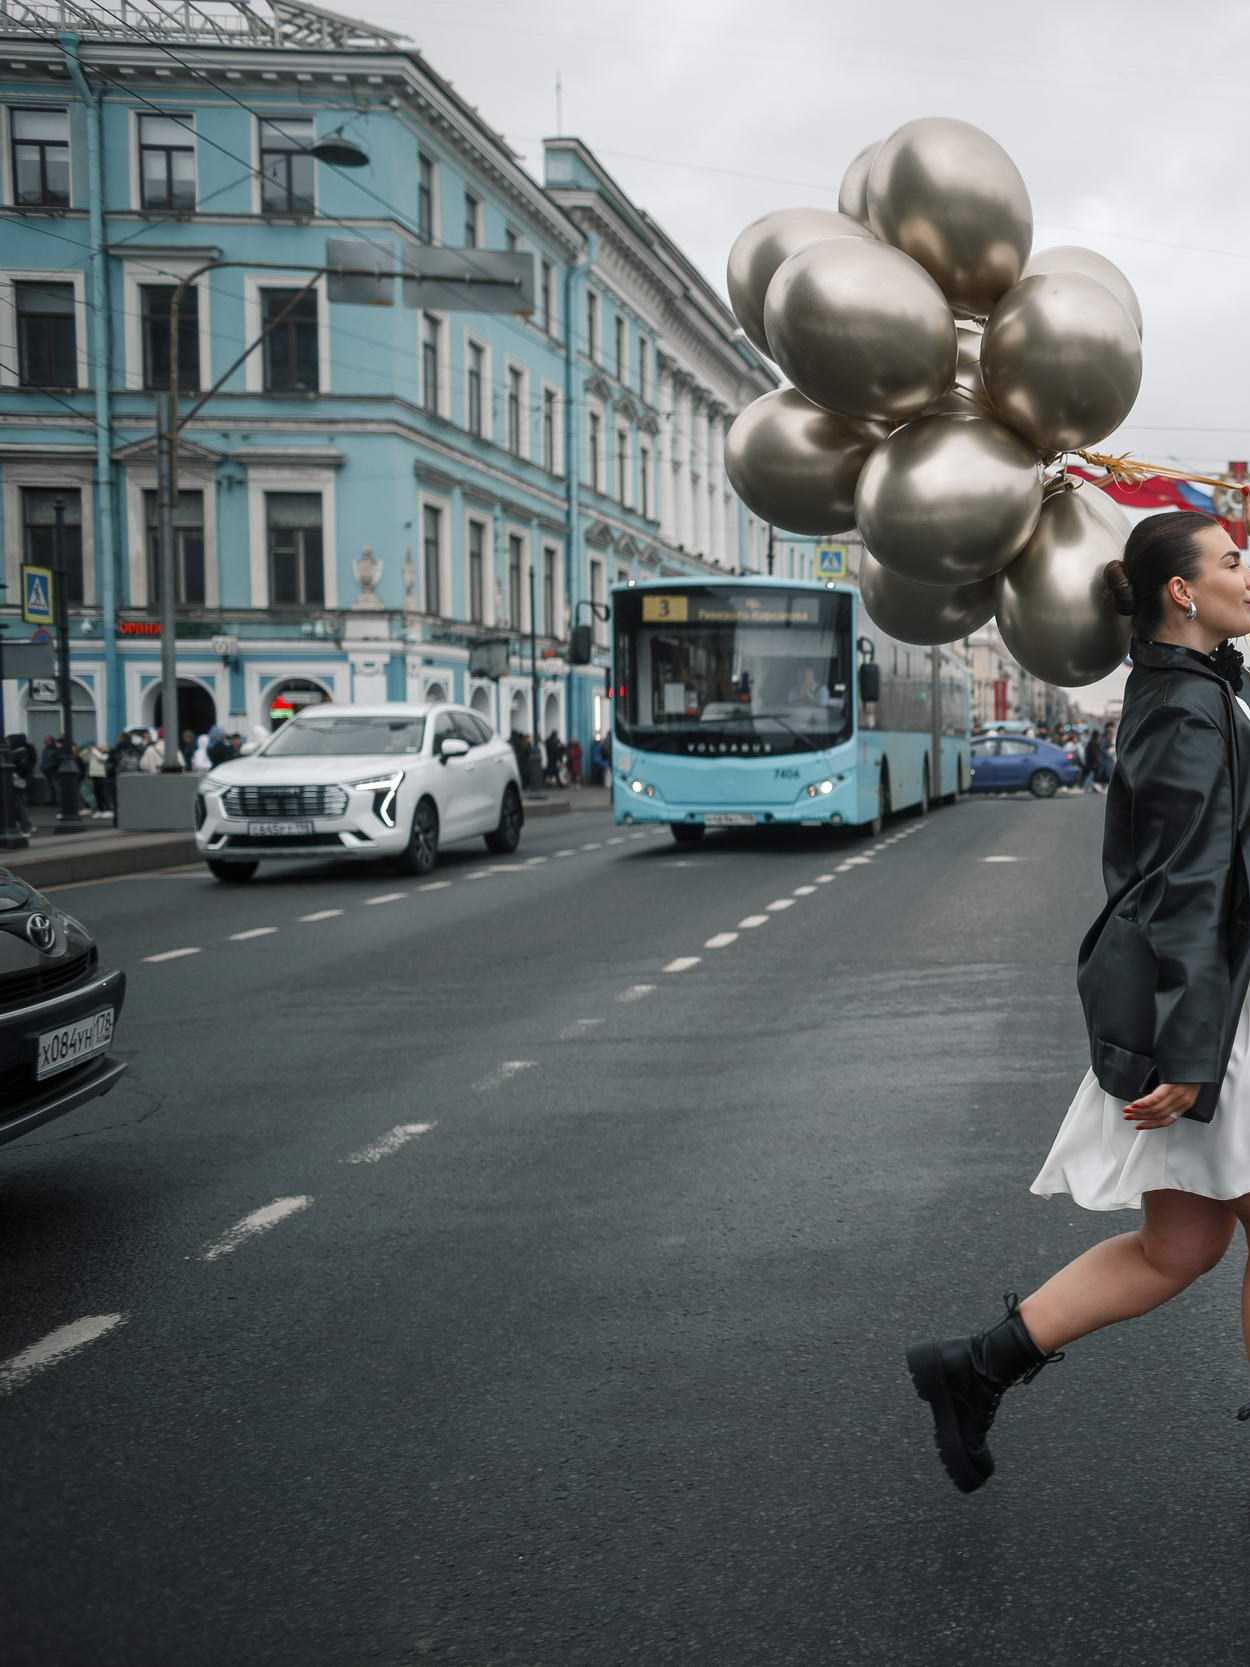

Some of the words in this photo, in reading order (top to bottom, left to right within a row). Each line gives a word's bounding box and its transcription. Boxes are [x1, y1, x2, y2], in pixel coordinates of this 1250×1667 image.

[658, 599, 670, 617] 3
[687, 743, 771, 753] VOLGABUS
[42, 1027, 93, 1066] Х084УН
[95, 1011, 111, 1035] 178
